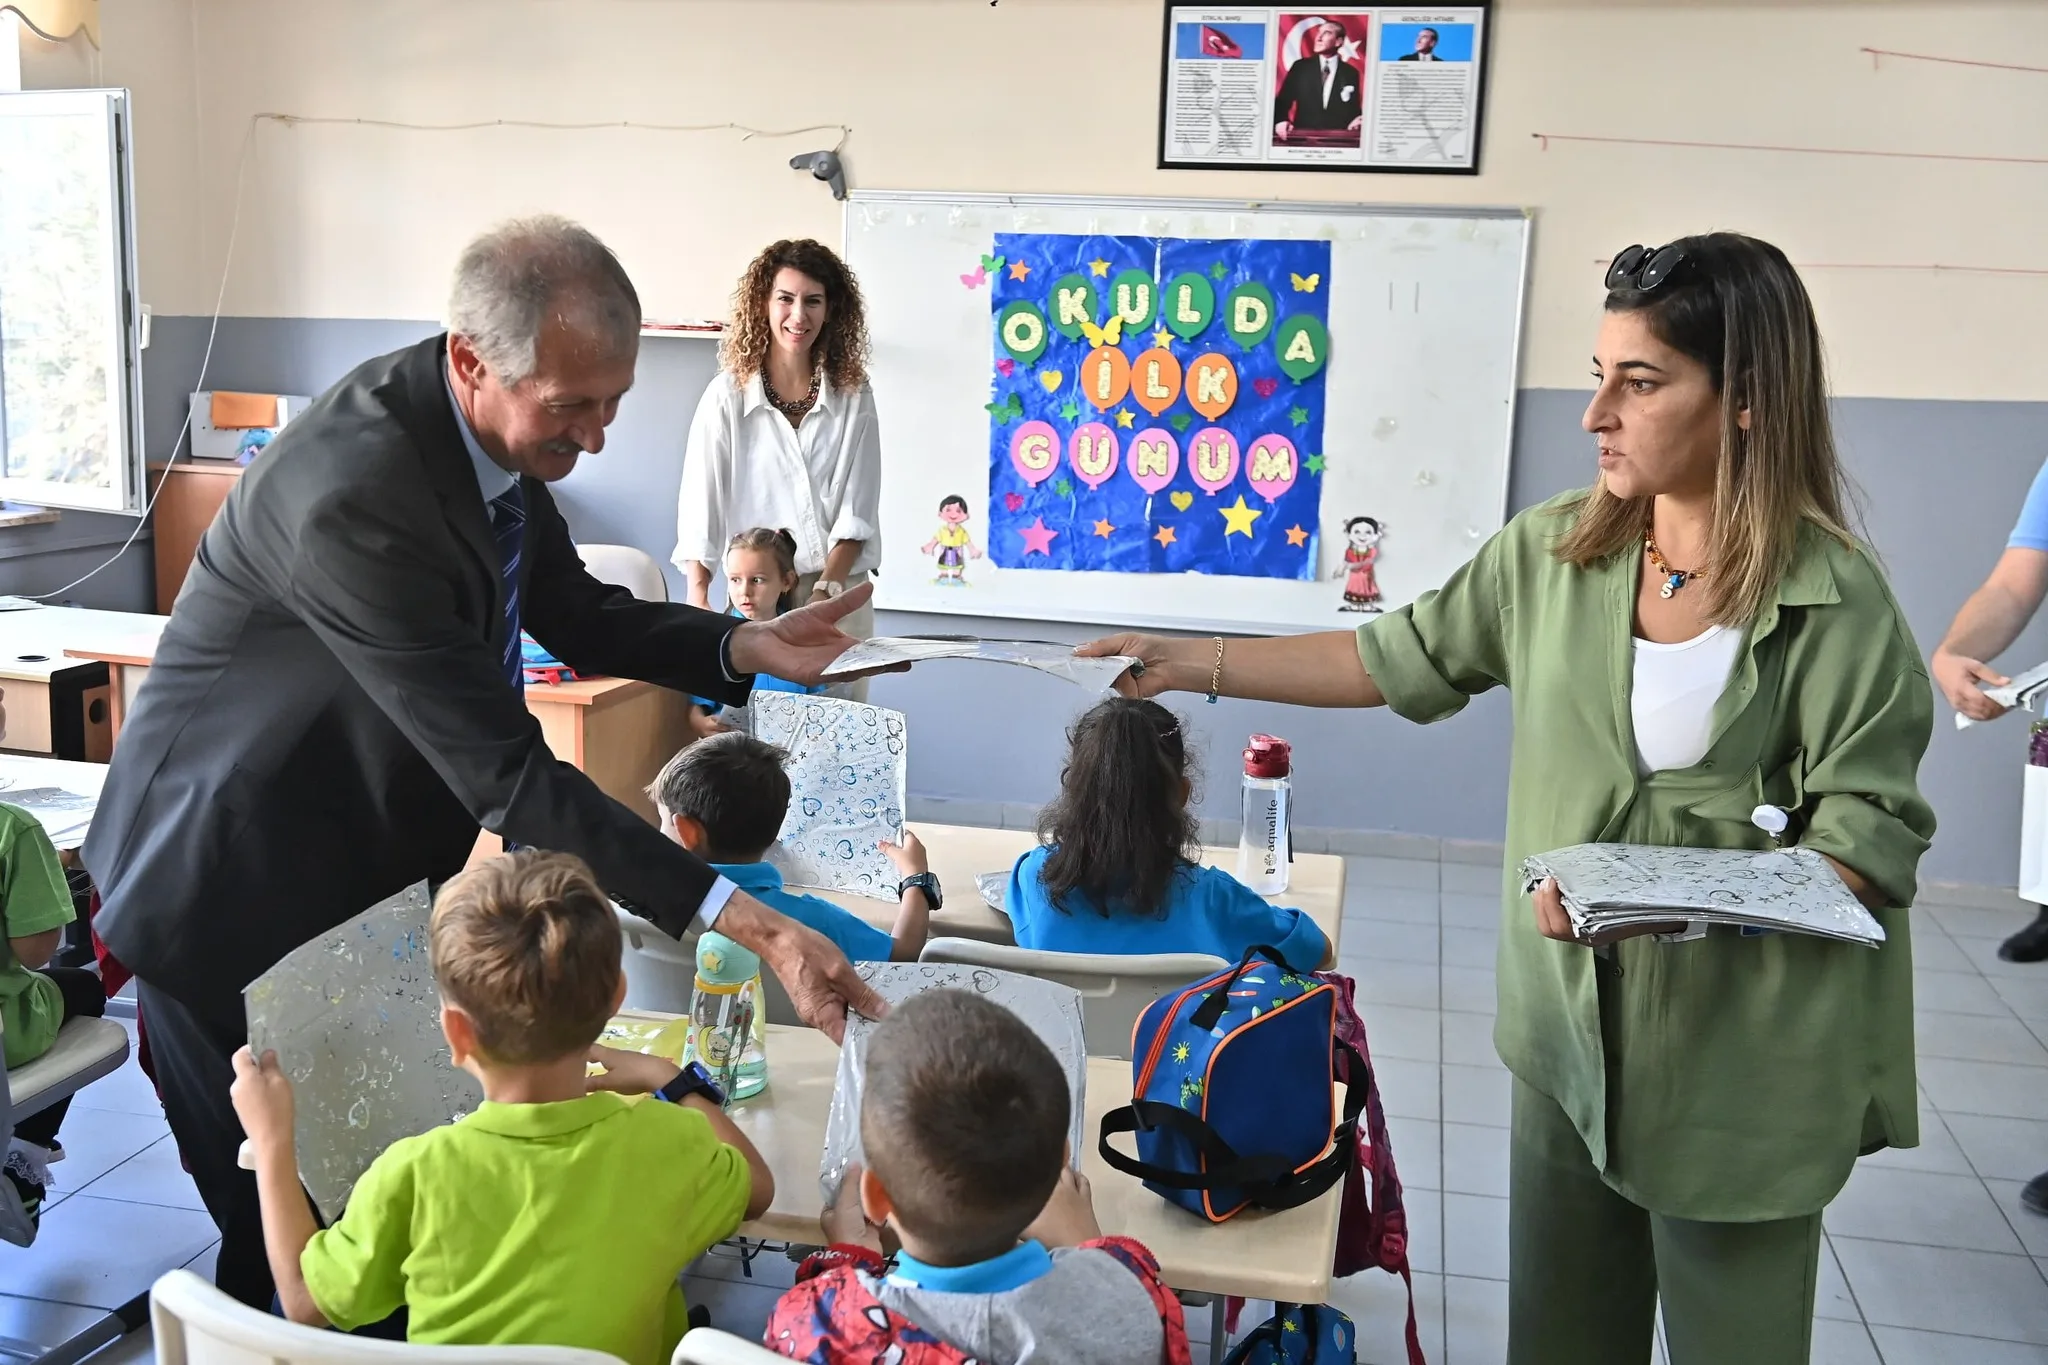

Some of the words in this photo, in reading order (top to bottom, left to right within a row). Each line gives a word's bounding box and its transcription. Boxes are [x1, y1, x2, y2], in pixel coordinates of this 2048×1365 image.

[1003, 283, 1317, 363] OKULDA
[1097, 351, 1229, 404] İLK
[1018, 427, 1293, 483] GÜNÜM
[1660, 582, 1673, 598] S
[1266, 799, 1278, 852] aqualife
